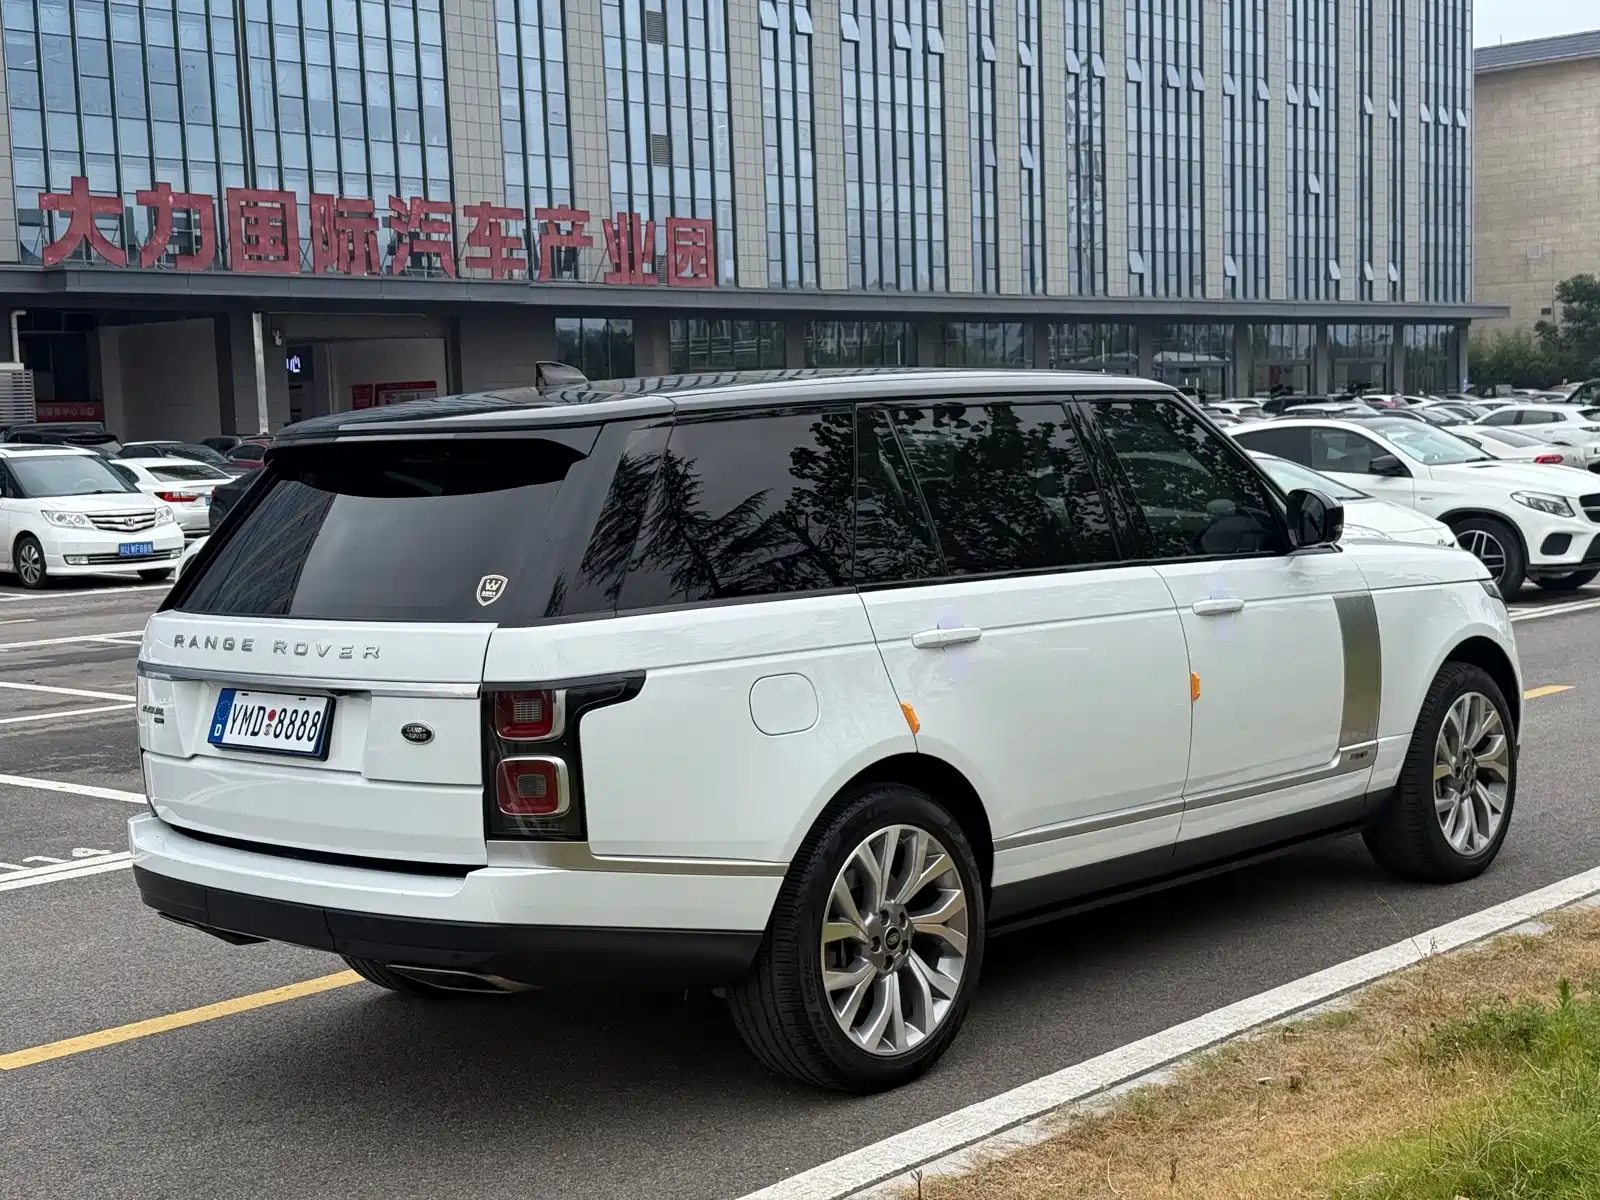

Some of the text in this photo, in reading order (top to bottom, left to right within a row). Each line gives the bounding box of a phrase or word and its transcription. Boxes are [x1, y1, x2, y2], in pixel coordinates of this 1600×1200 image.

[38, 176, 715, 287] 大力国际汽车产业园
[173, 634, 380, 660] RANGE ROVER
[213, 723, 222, 737] D
[273, 708, 321, 742] 8888
[406, 726, 423, 734] LAND
[408, 732, 428, 740] ROVER
